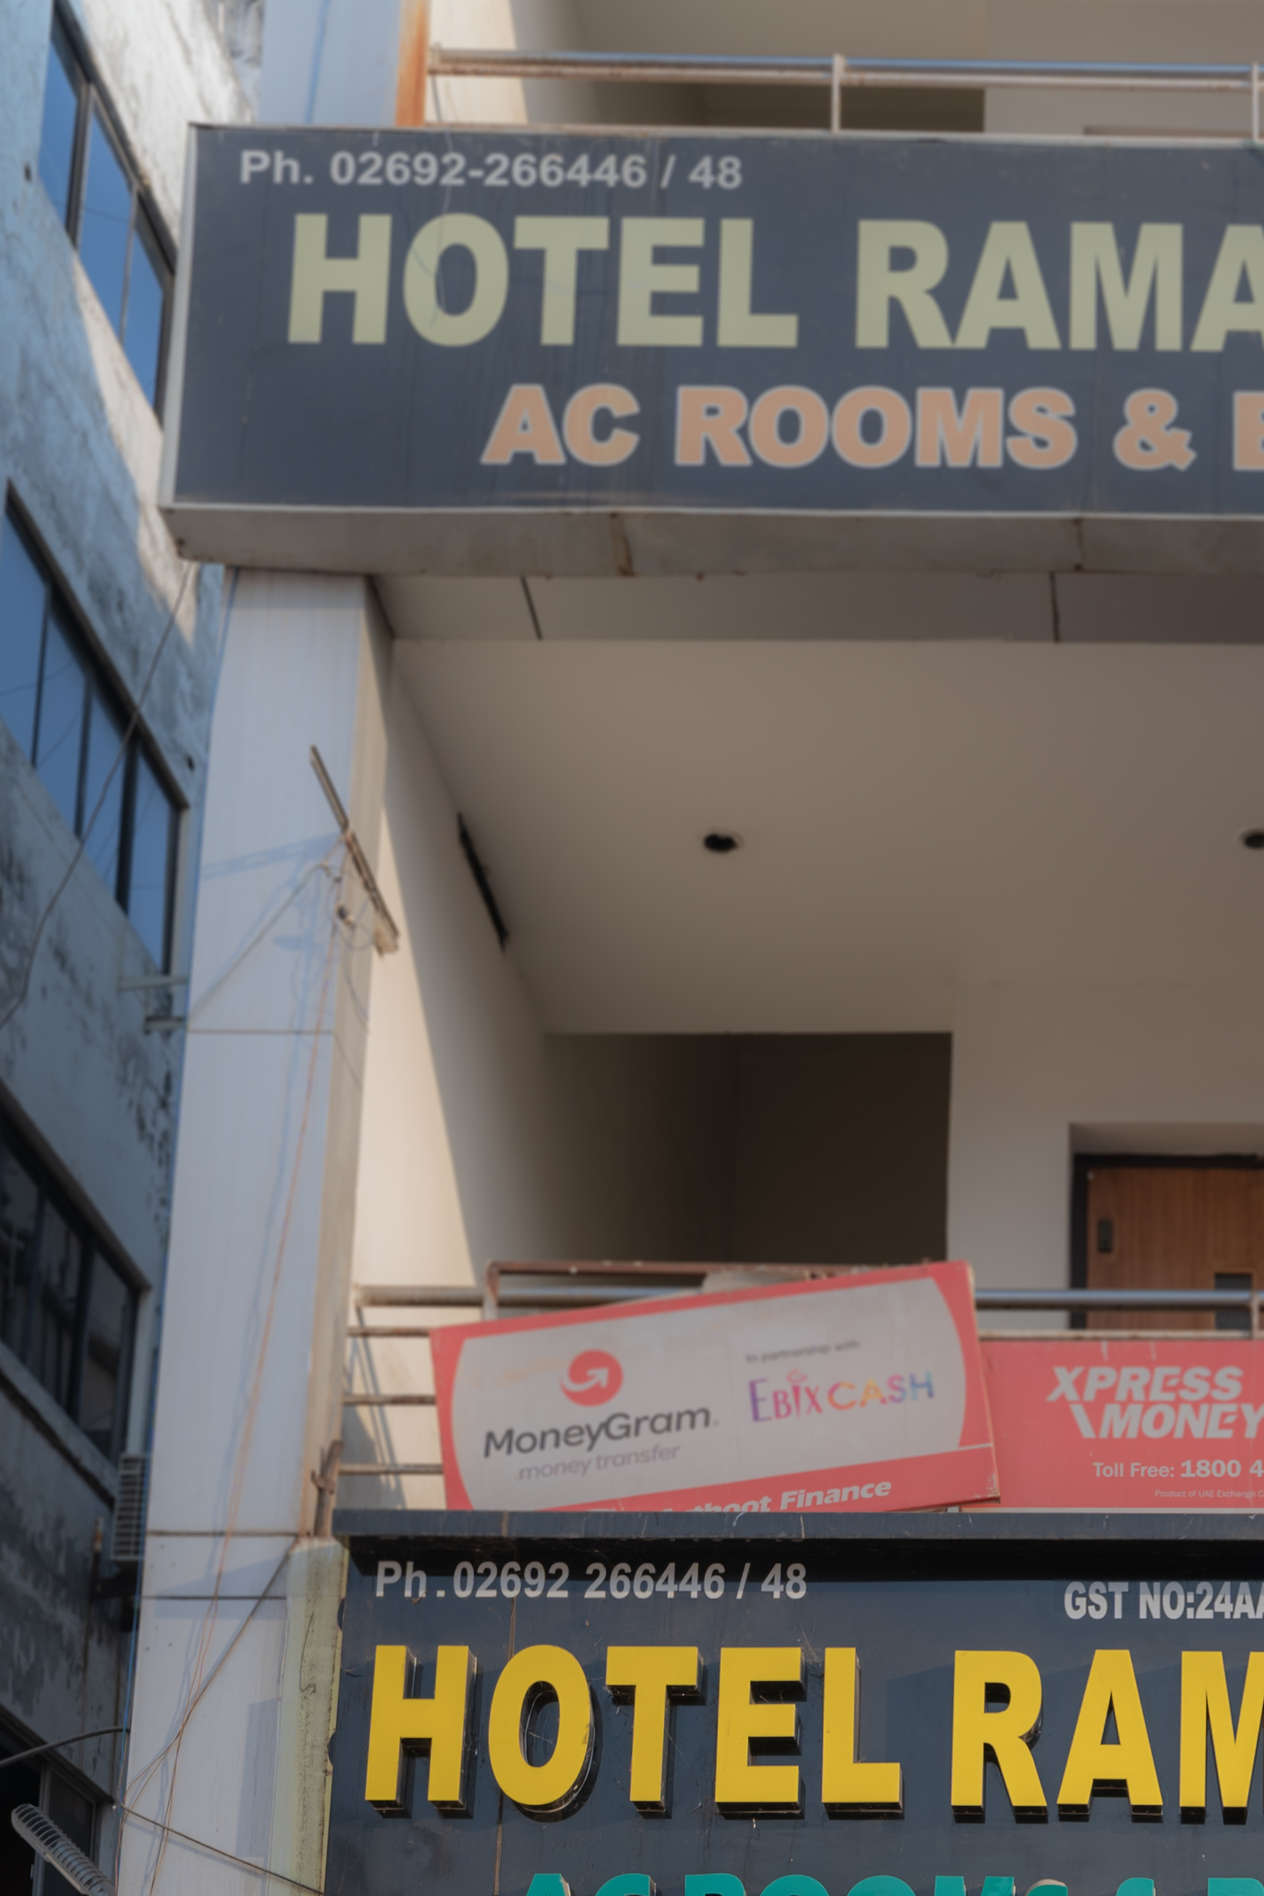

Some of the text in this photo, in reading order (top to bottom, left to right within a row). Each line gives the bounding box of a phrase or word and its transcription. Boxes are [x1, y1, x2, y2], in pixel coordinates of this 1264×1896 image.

[239, 150, 742, 190] Ph. 02692-266446 / 48
[286, 212, 798, 347] HOTEL
[480, 384, 640, 467] AC
[674, 385, 1077, 470] ROOMS
[1114, 388, 1195, 471] &
[1047, 1366, 1244, 1402] XPRESS
[482, 1407, 712, 1459] MoneyGram
[518, 1443, 681, 1481] money transfer
[1093, 1461, 1126, 1478] Toll
[1130, 1461, 1176, 1479] Free:
[1180, 1460, 1241, 1479] 1800
[780, 1481, 892, 1510] Finance
[585, 1562, 726, 1600] 266446
[735, 1563, 752, 1600] /
[760, 1564, 808, 1600] 48
[1064, 1581, 1125, 1621] GST
[364, 1644, 904, 1816] HOTEL
